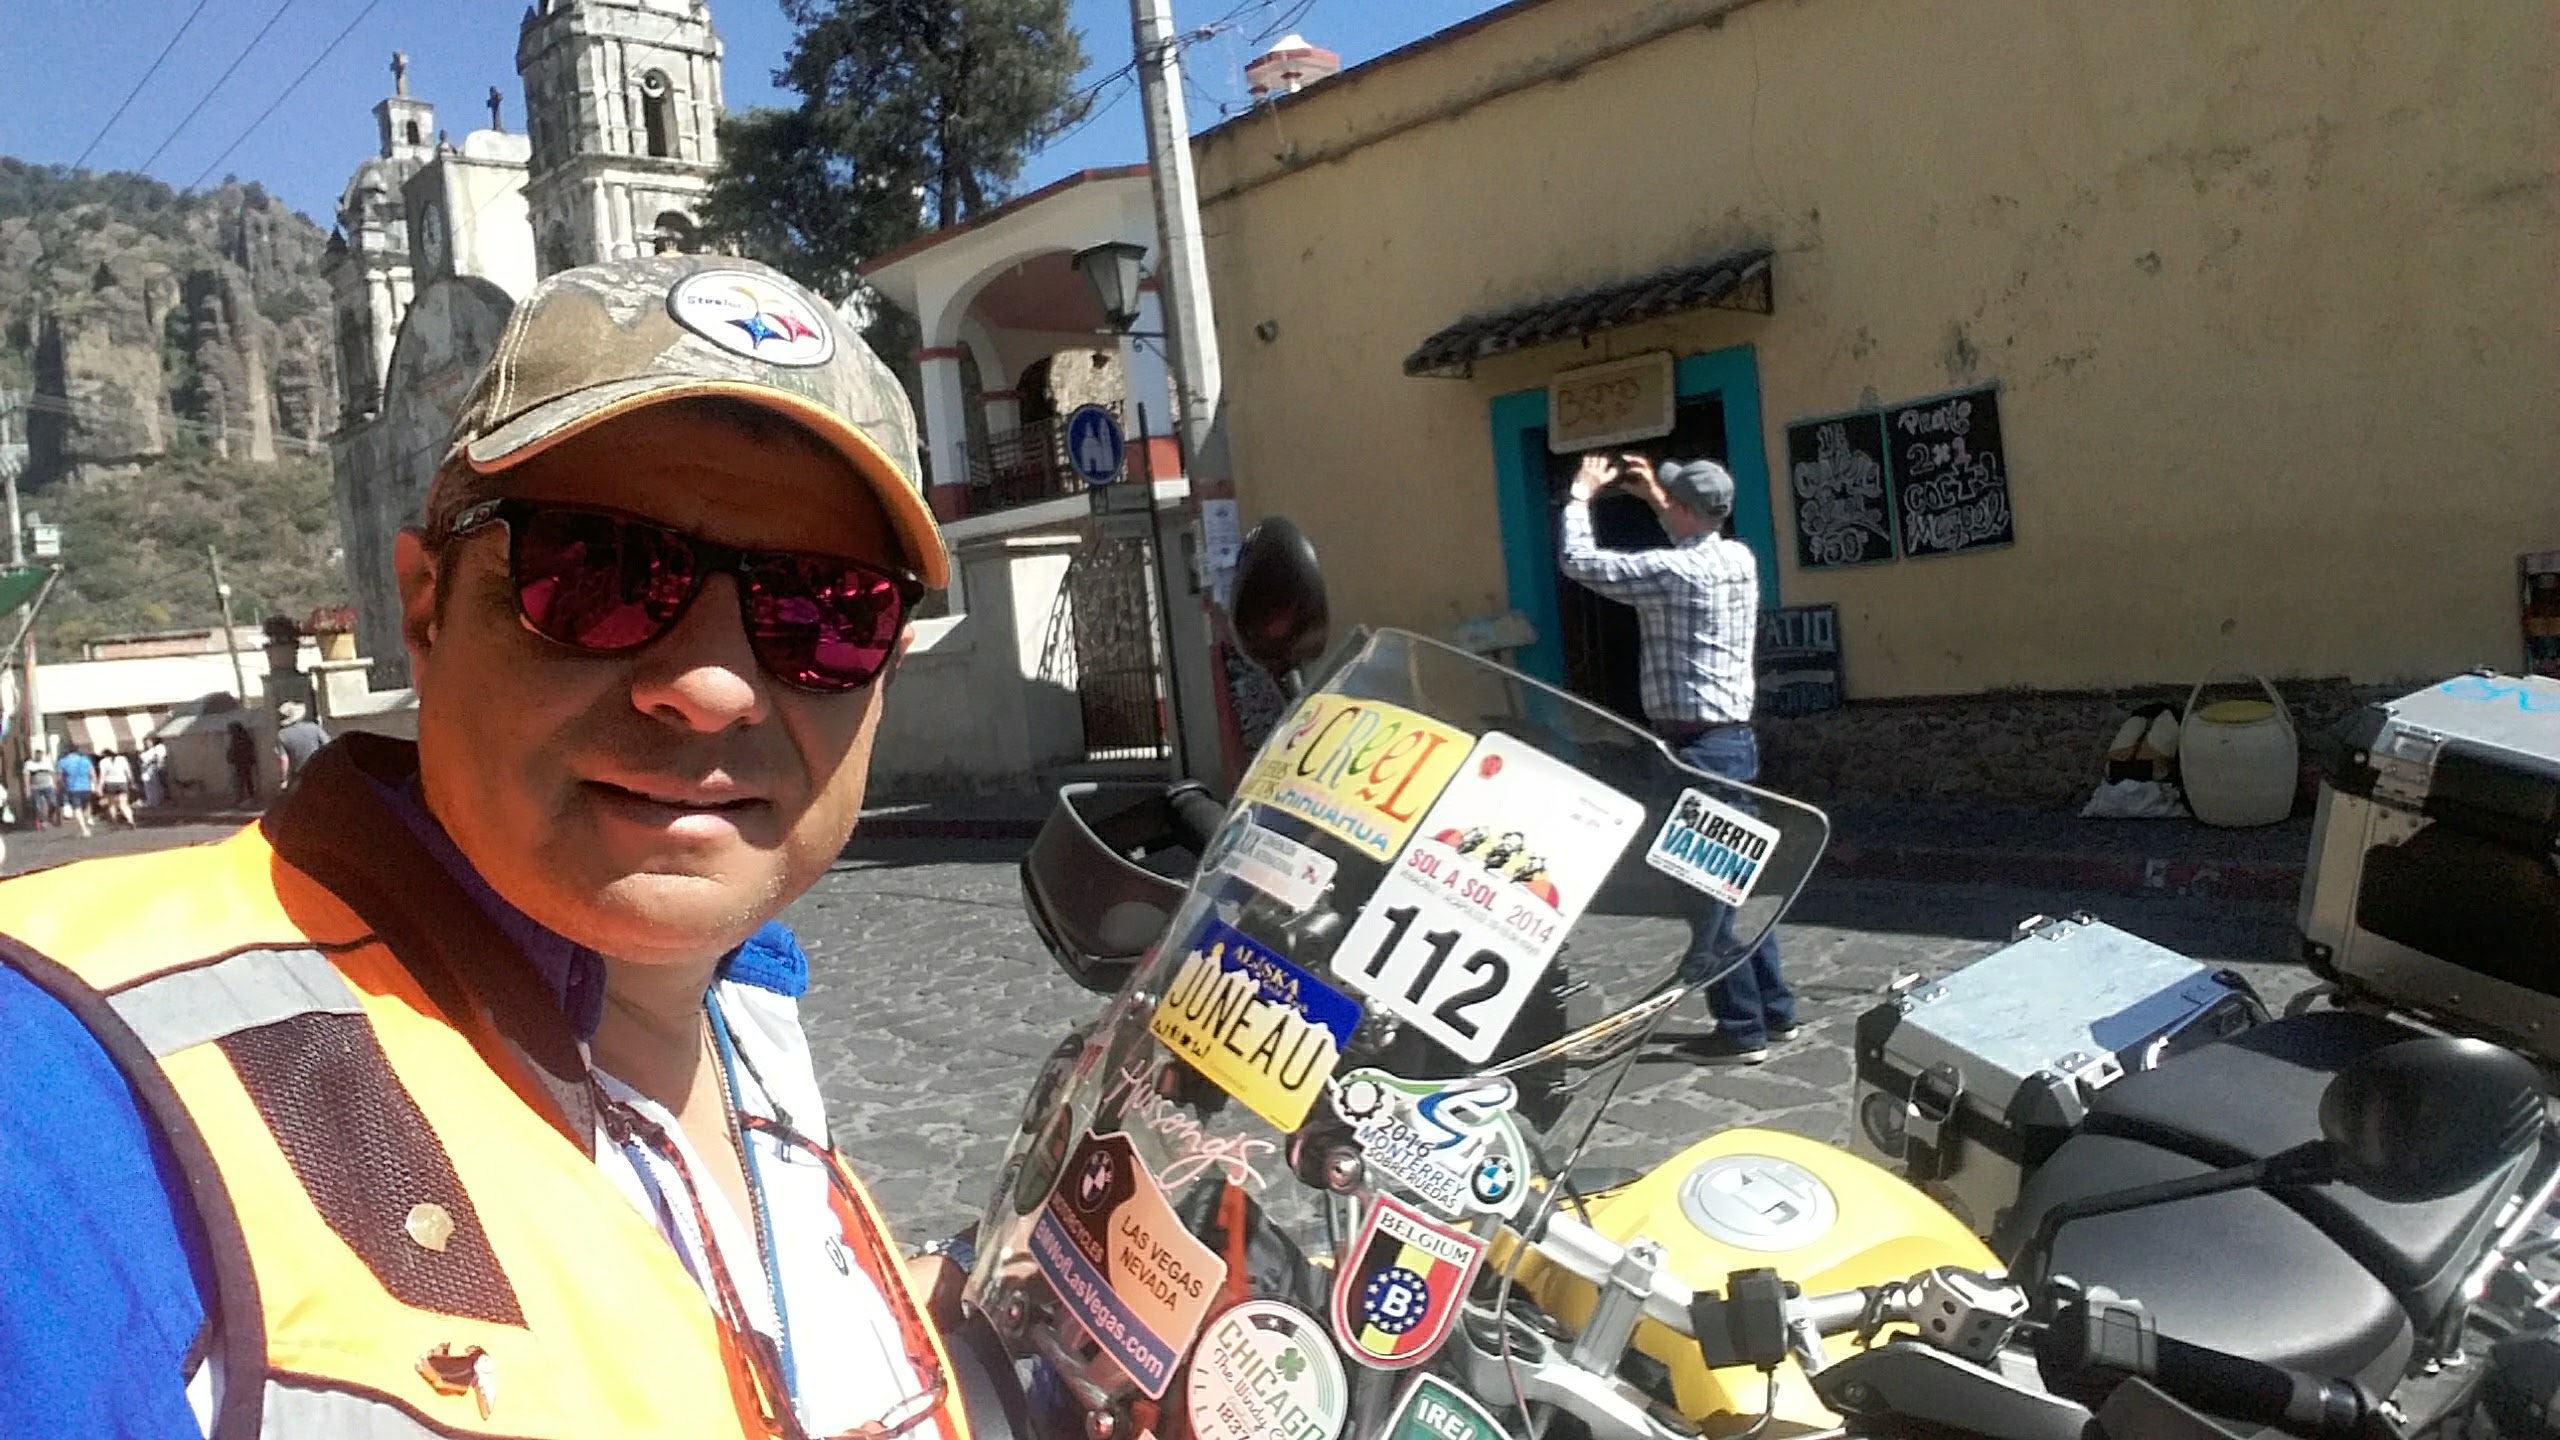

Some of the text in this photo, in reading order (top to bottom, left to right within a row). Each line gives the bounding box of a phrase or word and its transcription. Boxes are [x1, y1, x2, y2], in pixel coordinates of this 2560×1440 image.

[1660, 821, 1758, 890] VANONI
[1407, 848, 1555, 944] SOL A SOL 2014
[1363, 904, 1511, 1042] 112
[1168, 958, 1329, 1092] JUNEAU
[1358, 1124, 1467, 1198] MONTERREY
[1376, 1114, 1435, 1159] 2016
[1365, 1146, 1458, 1210] SOBRE RUEDAS
[1120, 1215, 1204, 1299] LAS VEGAS
[1379, 1211, 1471, 1264] BELGIUM
[1118, 1247, 1179, 1312] NEVADA
[1379, 1283, 1413, 1318] B
[1233, 1377, 1268, 1433] Windy
